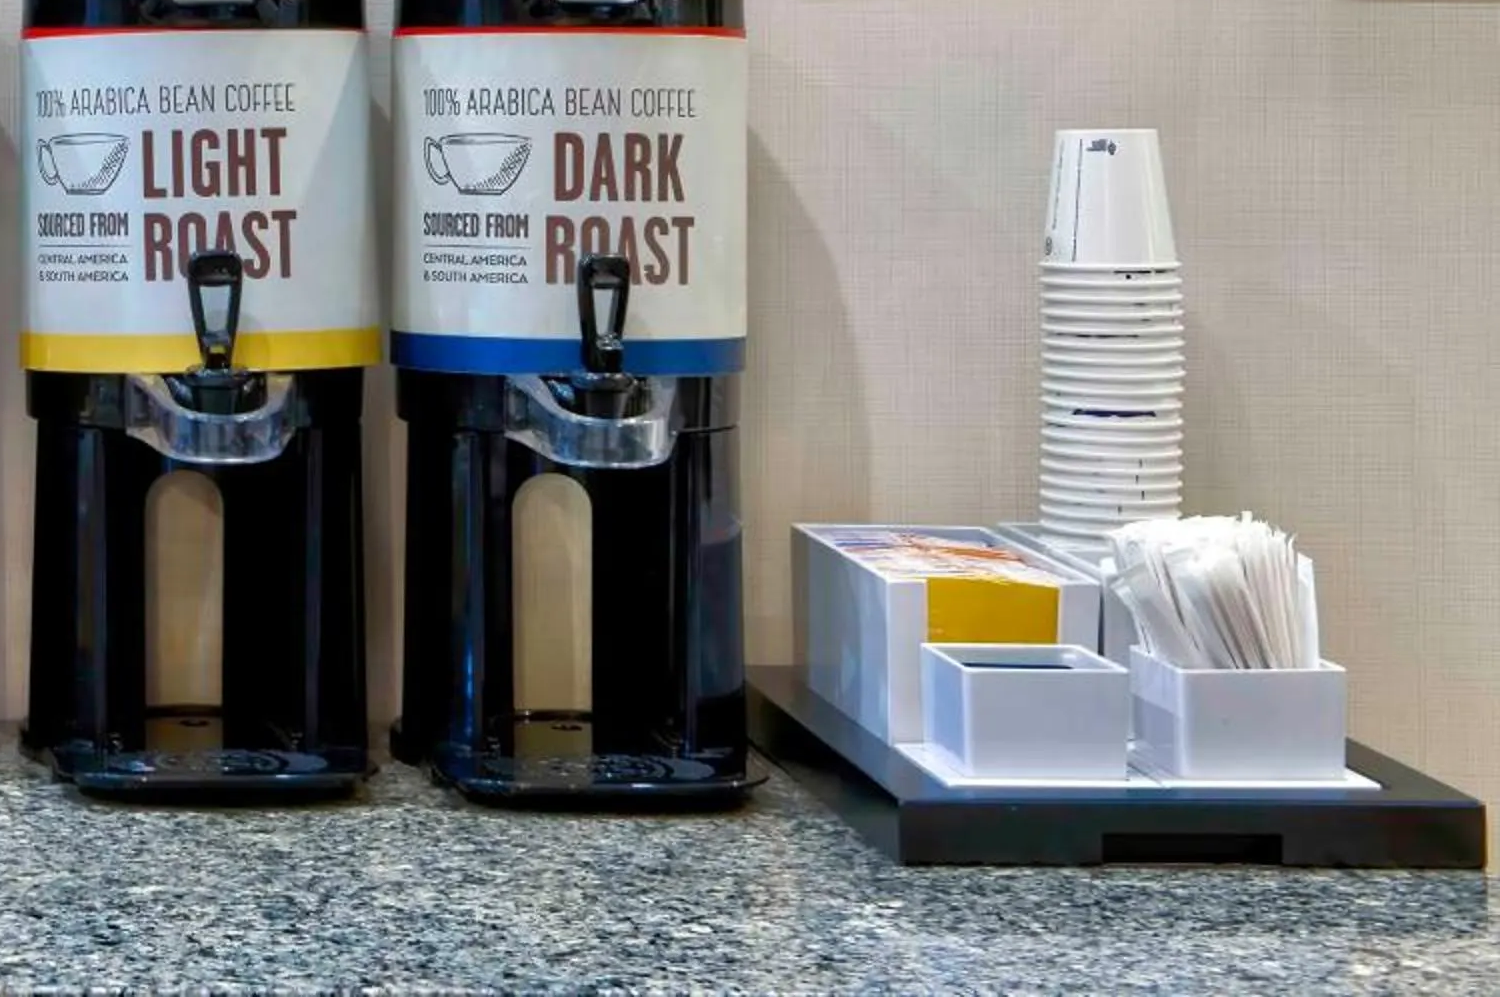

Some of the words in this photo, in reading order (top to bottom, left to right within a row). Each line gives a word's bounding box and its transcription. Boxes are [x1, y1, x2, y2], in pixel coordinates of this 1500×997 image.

[36, 90, 66, 118] 100%
[71, 86, 151, 116] ARABICA
[159, 84, 216, 114] BEAN
[225, 83, 296, 112] COFFEE
[423, 89, 461, 117] 100%
[466, 88, 555, 117] ARABICA
[565, 88, 621, 117] BEAN
[631, 88, 696, 118] COFFEE
[142, 127, 288, 198] LIGHT
[554, 132, 685, 202] DARK
[38, 212, 85, 237] SOURCED
[89, 212, 129, 237] FROM
[423, 211, 480, 238] SOURCED
[485, 213, 529, 239] FROM
[78, 253, 129, 265] AMERICA
[143, 209, 297, 281] ROAST
[423, 252, 469, 266] CENTRAL
[470, 254, 528, 266] AMERICA
[545, 215, 695, 286] ROAST
[77, 270, 129, 282] AMERICA
[432, 270, 467, 282] SOUTH
[469, 272, 529, 284] AMERICA
